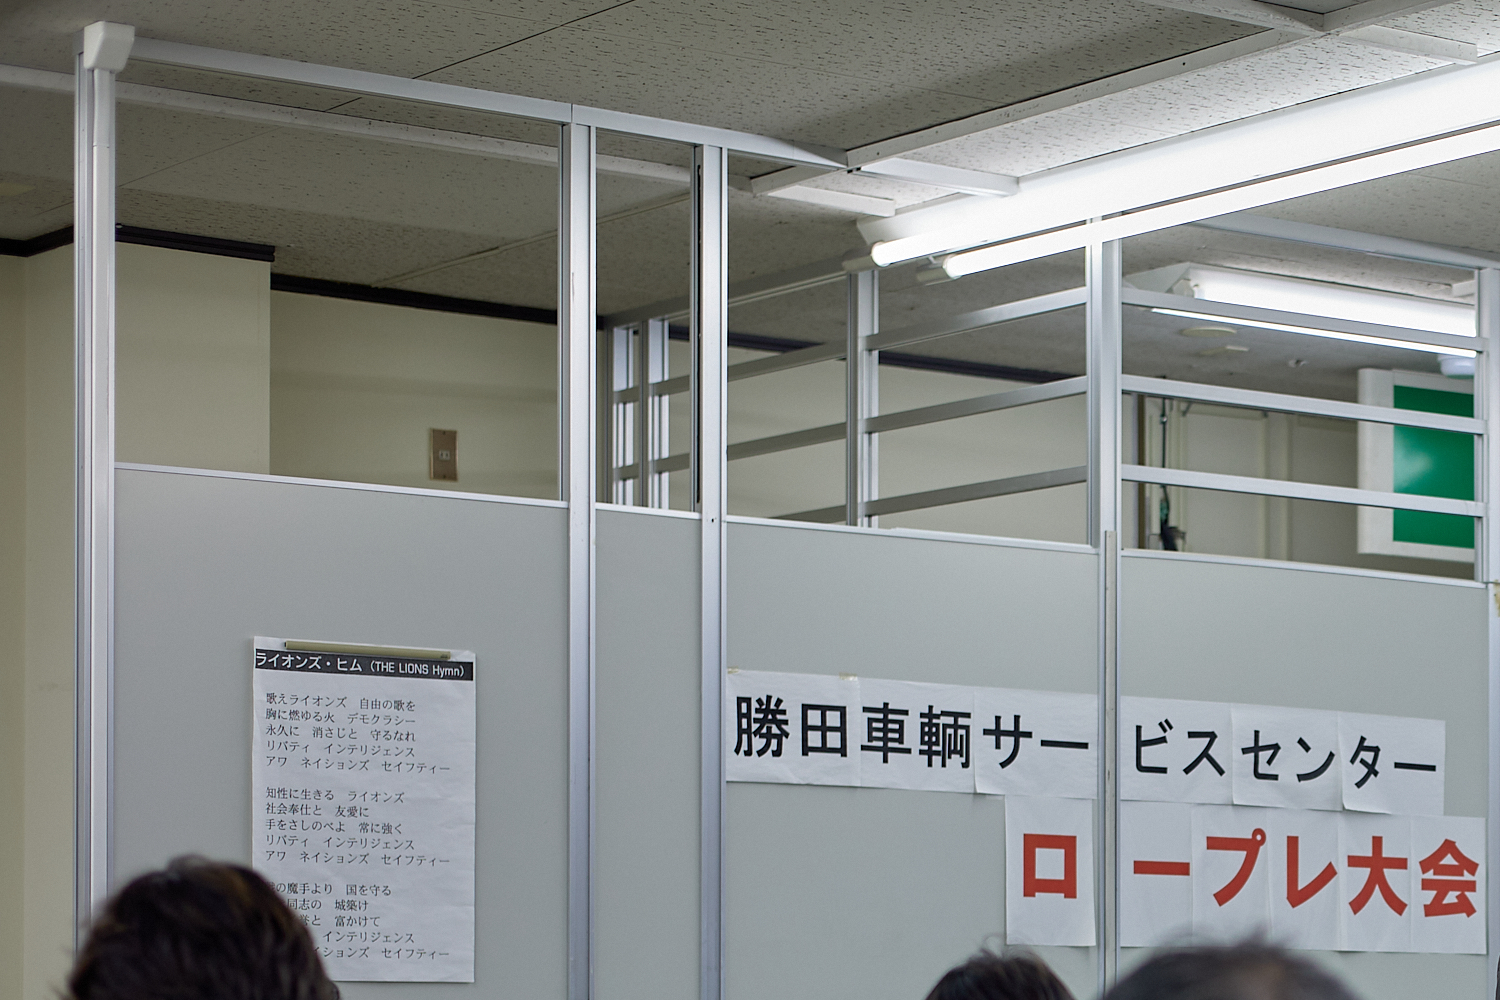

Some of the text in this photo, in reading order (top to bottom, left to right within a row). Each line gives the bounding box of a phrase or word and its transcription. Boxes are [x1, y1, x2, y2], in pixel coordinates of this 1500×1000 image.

[399, 662, 428, 675] LIONS
[266, 693, 415, 712] 歌えライオンズ 自由の歌を
[348, 713, 416, 725] デモクラシー
[266, 724, 416, 742] 永久に 消さじと 守るなれ
[267, 740, 414, 757] リバティ インテリジェンス
[266, 756, 450, 773] アワ ネイションズ セイフティー
[266, 787, 404, 803] 知性に生きる ライオンズ
[266, 803, 369, 818] 社会奉仕と 友愛に
[266, 819, 402, 834] 手をさしのべよ 常に強く
[266, 835, 414, 850] リバティ インテリジェンス
[266, 851, 450, 867] アワ ネイションズ セイフティー
[1023, 829, 1480, 918] ロープレ大会
[346, 884, 391, 896] 国を守る
[335, 900, 368, 911] 城築け
[335, 916, 380, 927] 富かけて
[323, 931, 414, 943] インテリジェンス
[382, 948, 450, 960] セイフティー
